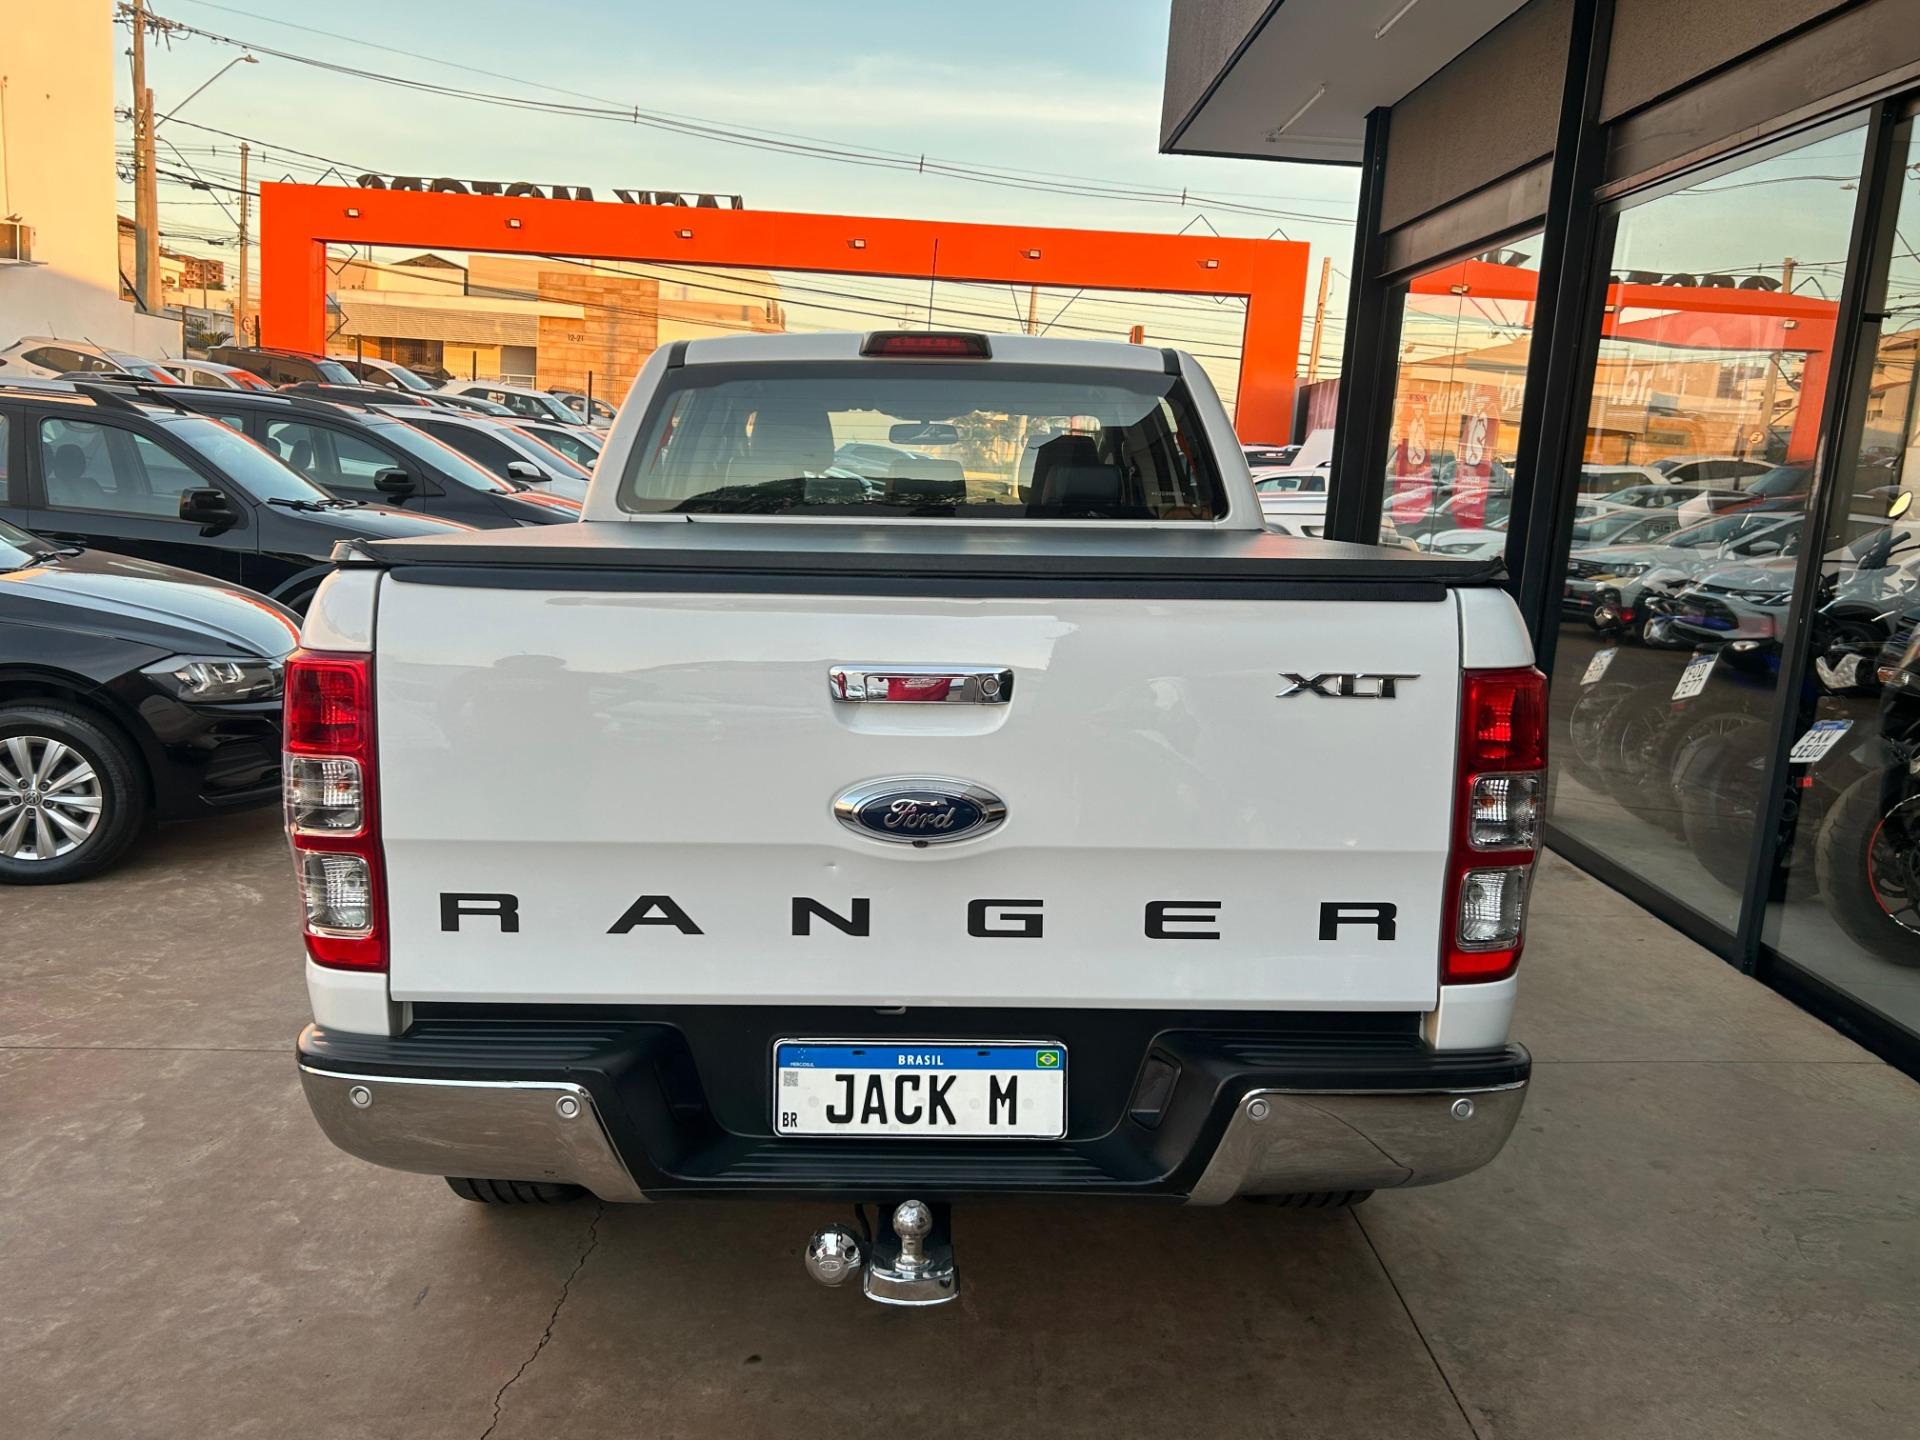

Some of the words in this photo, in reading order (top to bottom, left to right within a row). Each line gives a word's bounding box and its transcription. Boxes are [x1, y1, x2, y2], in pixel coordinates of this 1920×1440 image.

[1275, 672, 1421, 699] XLT
[883, 798, 955, 829] Ford
[439, 892, 1397, 941] RANGER
[898, 1054, 944, 1066] BRASIL
[826, 1074, 957, 1125] JACK
[989, 1075, 1018, 1125] M
[782, 1111, 798, 1128] BR
